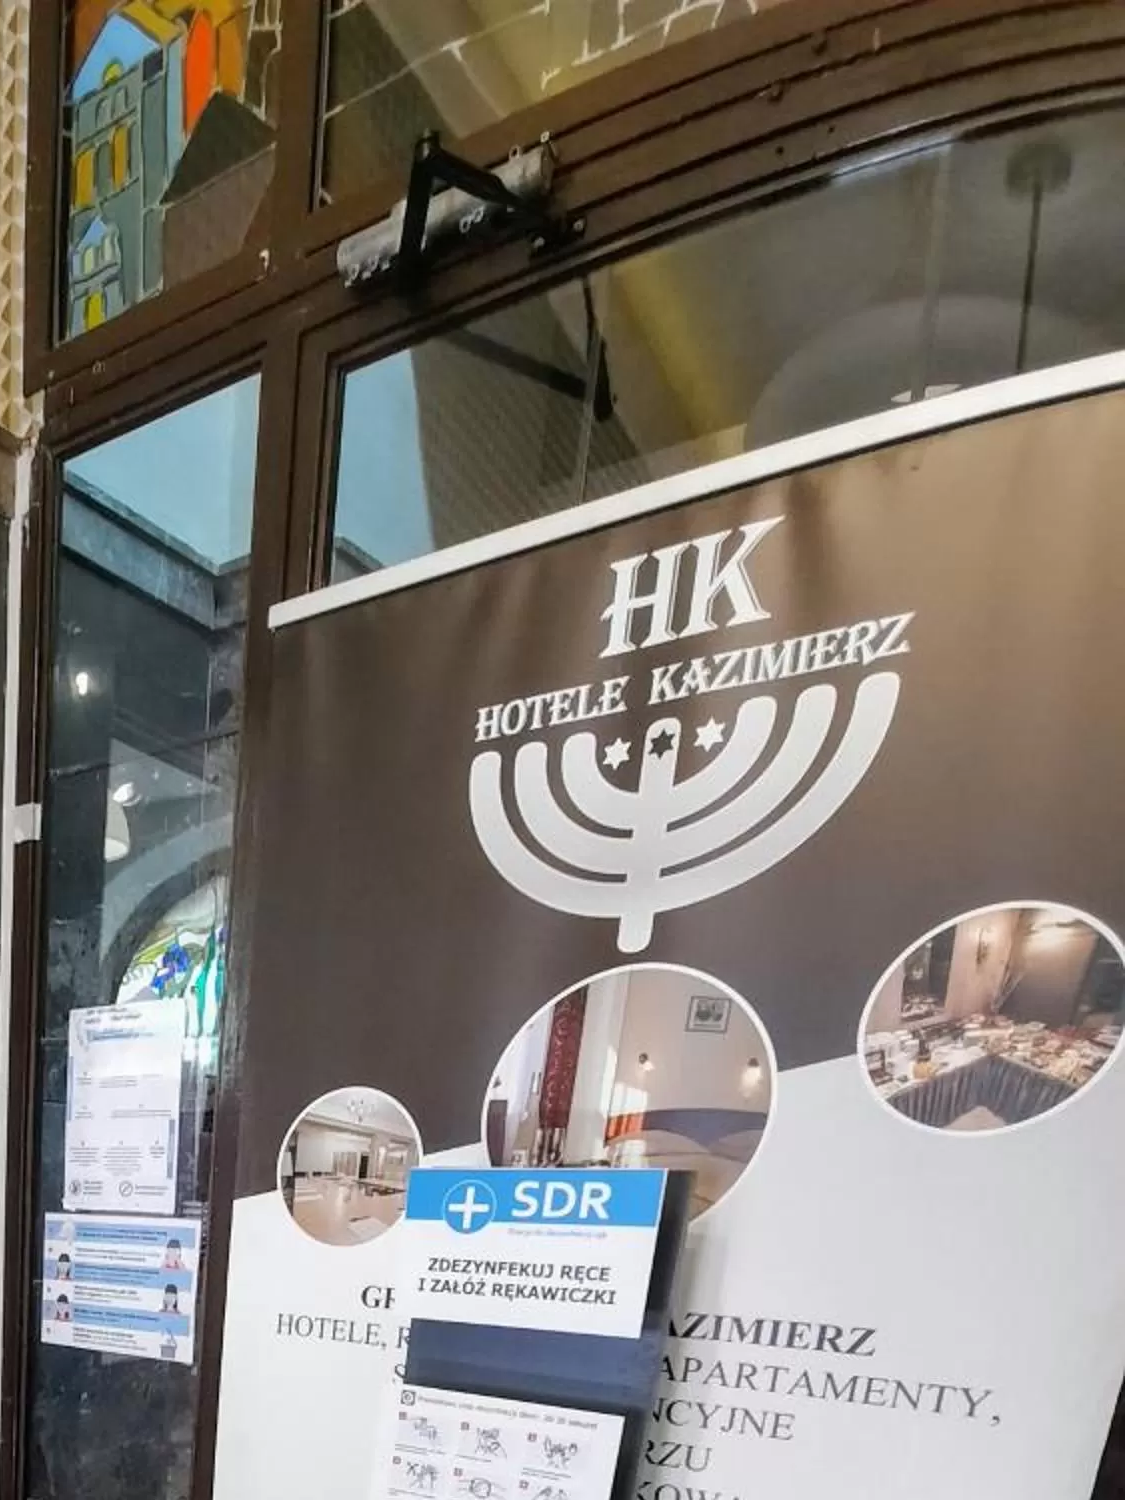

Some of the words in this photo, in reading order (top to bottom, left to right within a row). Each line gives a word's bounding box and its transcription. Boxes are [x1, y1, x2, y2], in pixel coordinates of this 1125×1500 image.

[598, 514, 786, 659] HK
[474, 676, 630, 743] HOTELE
[648, 611, 917, 706] KAZIMIERZ
[511, 1181, 613, 1220] SDR
[428, 1257, 554, 1279] ZDEZYNFEKUJ
[561, 1265, 611, 1282] RĘCE
[418, 1278, 426, 1292] I
[431, 1277, 486, 1297] ZAŁÓŻ
[491, 1283, 617, 1305] RĘKAWICZKI
[276, 1313, 388, 1350] HOTELE,
